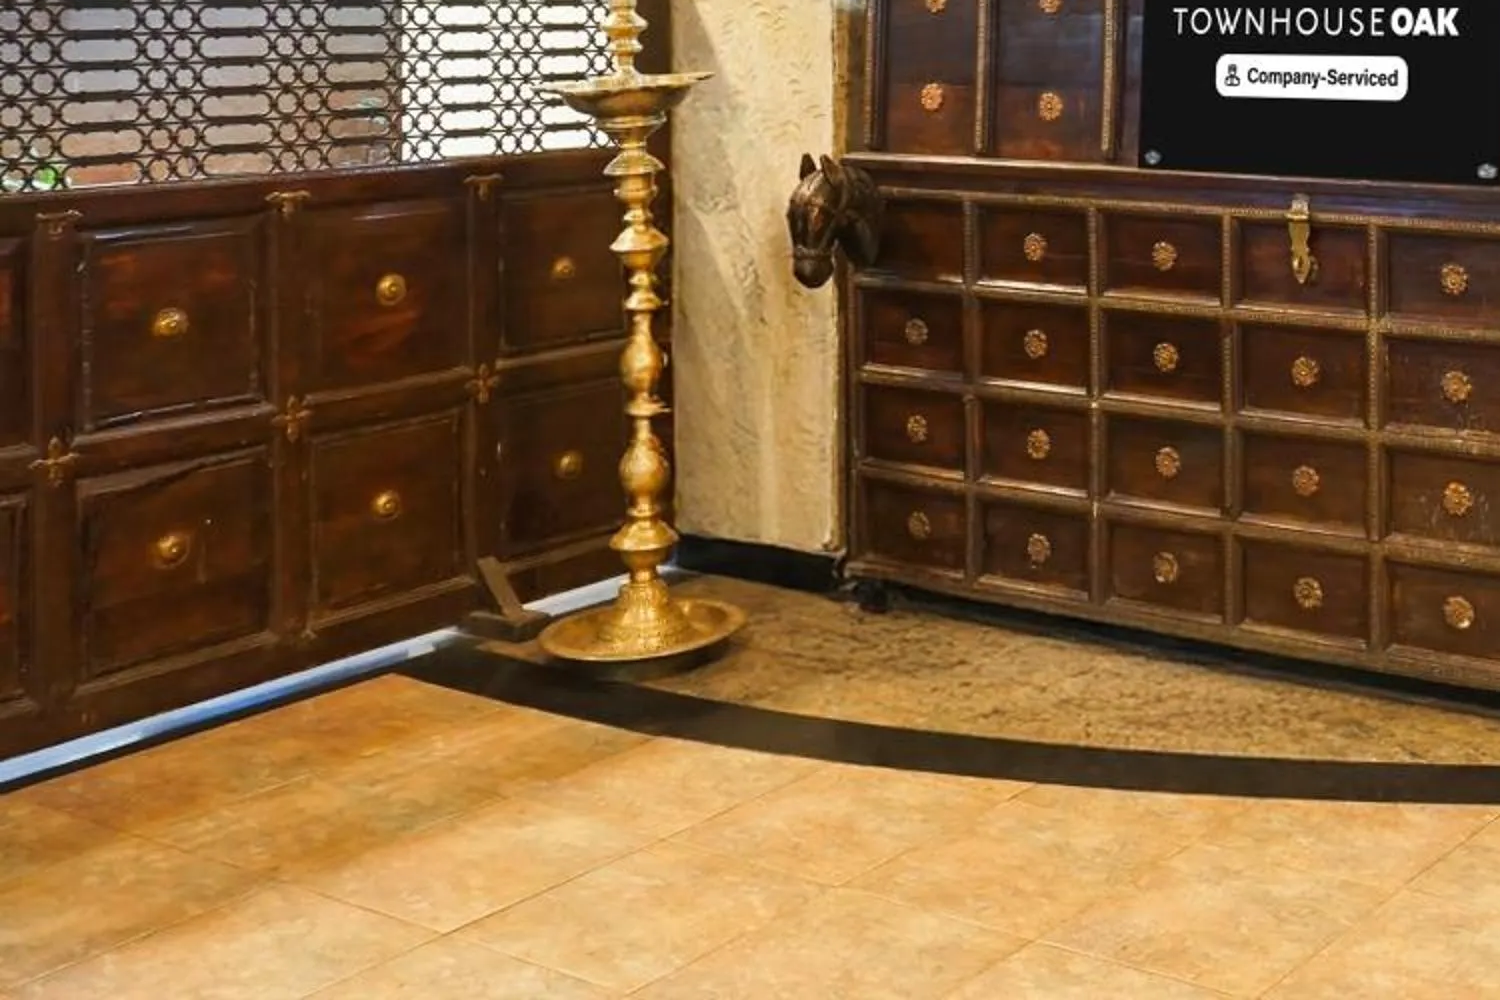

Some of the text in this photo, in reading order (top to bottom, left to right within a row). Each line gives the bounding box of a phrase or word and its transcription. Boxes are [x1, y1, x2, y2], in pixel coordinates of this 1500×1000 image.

[1173, 7, 1460, 37] TOWNHOUSE OAK
[1247, 67, 1399, 89] Company-Serviced
